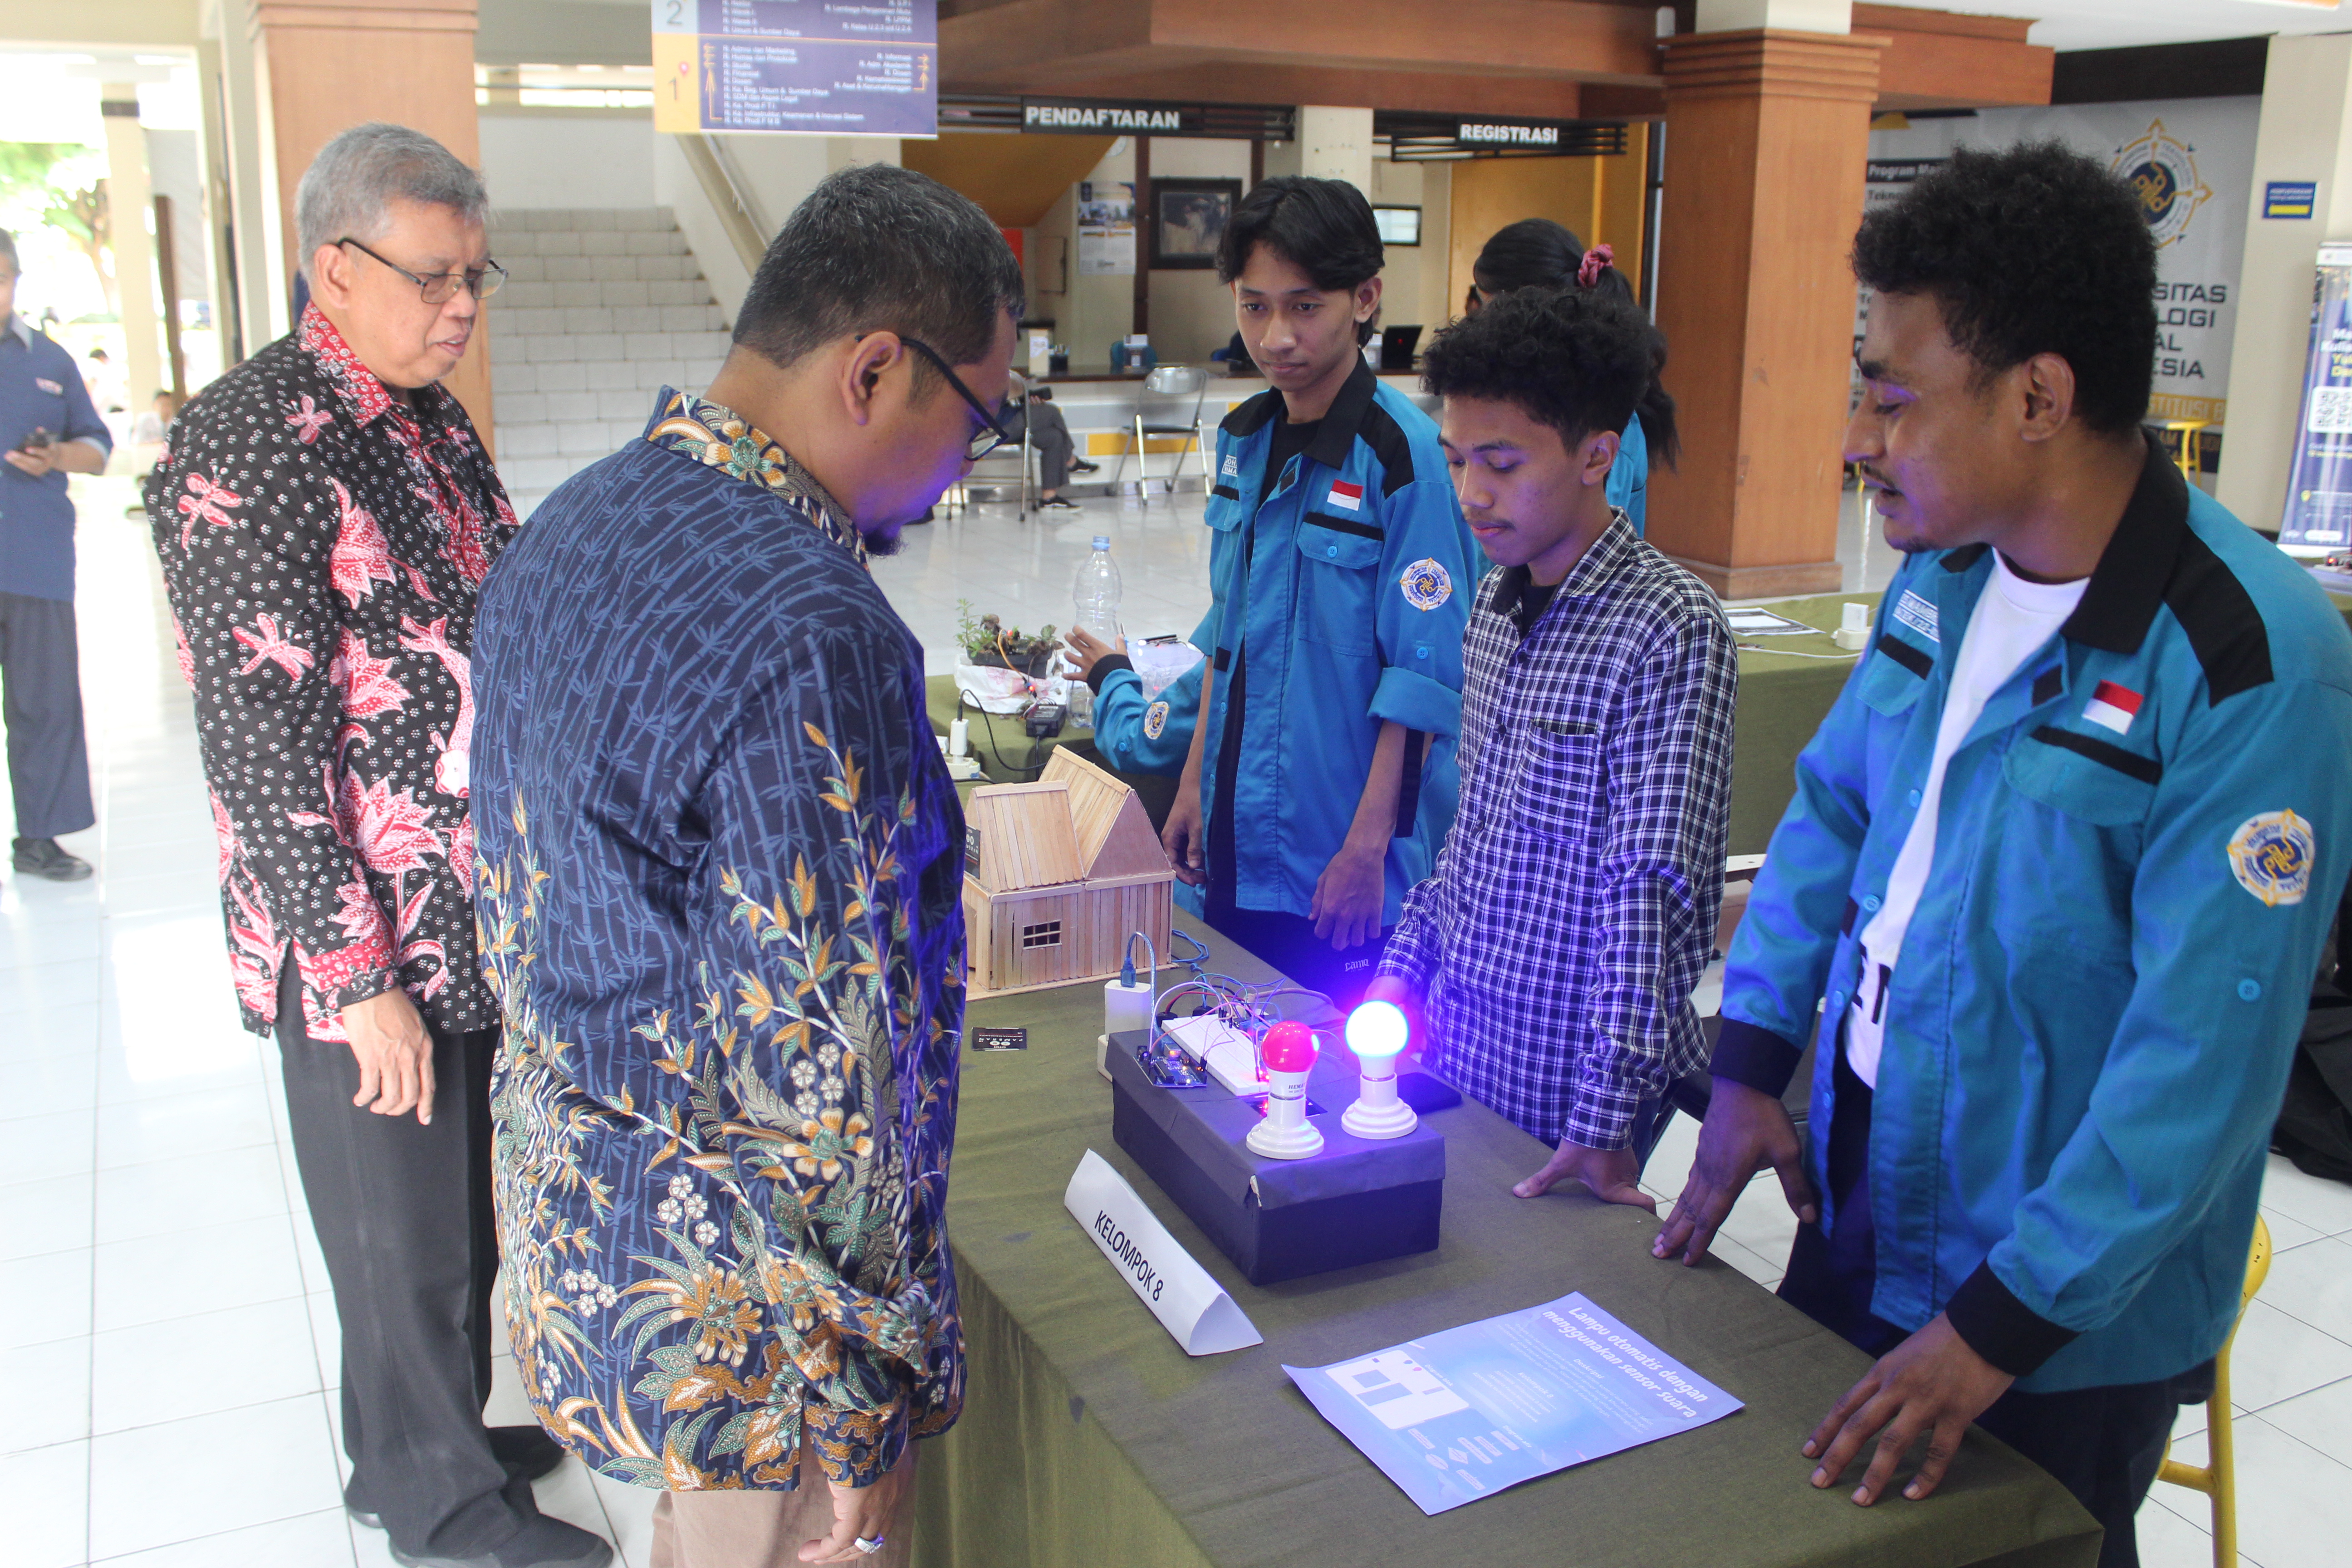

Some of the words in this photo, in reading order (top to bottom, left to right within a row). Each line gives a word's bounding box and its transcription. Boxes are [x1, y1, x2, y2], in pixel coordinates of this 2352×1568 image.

[1025, 106, 1180, 130] PENDAFTARAN
[1460, 123, 1558, 145] REGISTRASI
[1867, 164, 1916, 180] Program
[1094, 1210, 1156, 1292] KELOMPOK
[1152, 1279, 1163, 1301] 8
[1543, 1311, 1622, 1363] menggunakan
[1618, 1364, 1661, 1390] sensor
[1656, 1392, 1696, 1417] suara
[1568, 1307, 1610, 1334] Lampu
[1607, 1335, 1662, 1369] otomatis
[1659, 1371, 1707, 1401] dengan
[1573, 1359, 1603, 1378] Deskripsi
[1518, 1372, 1548, 1394] Kelompok
